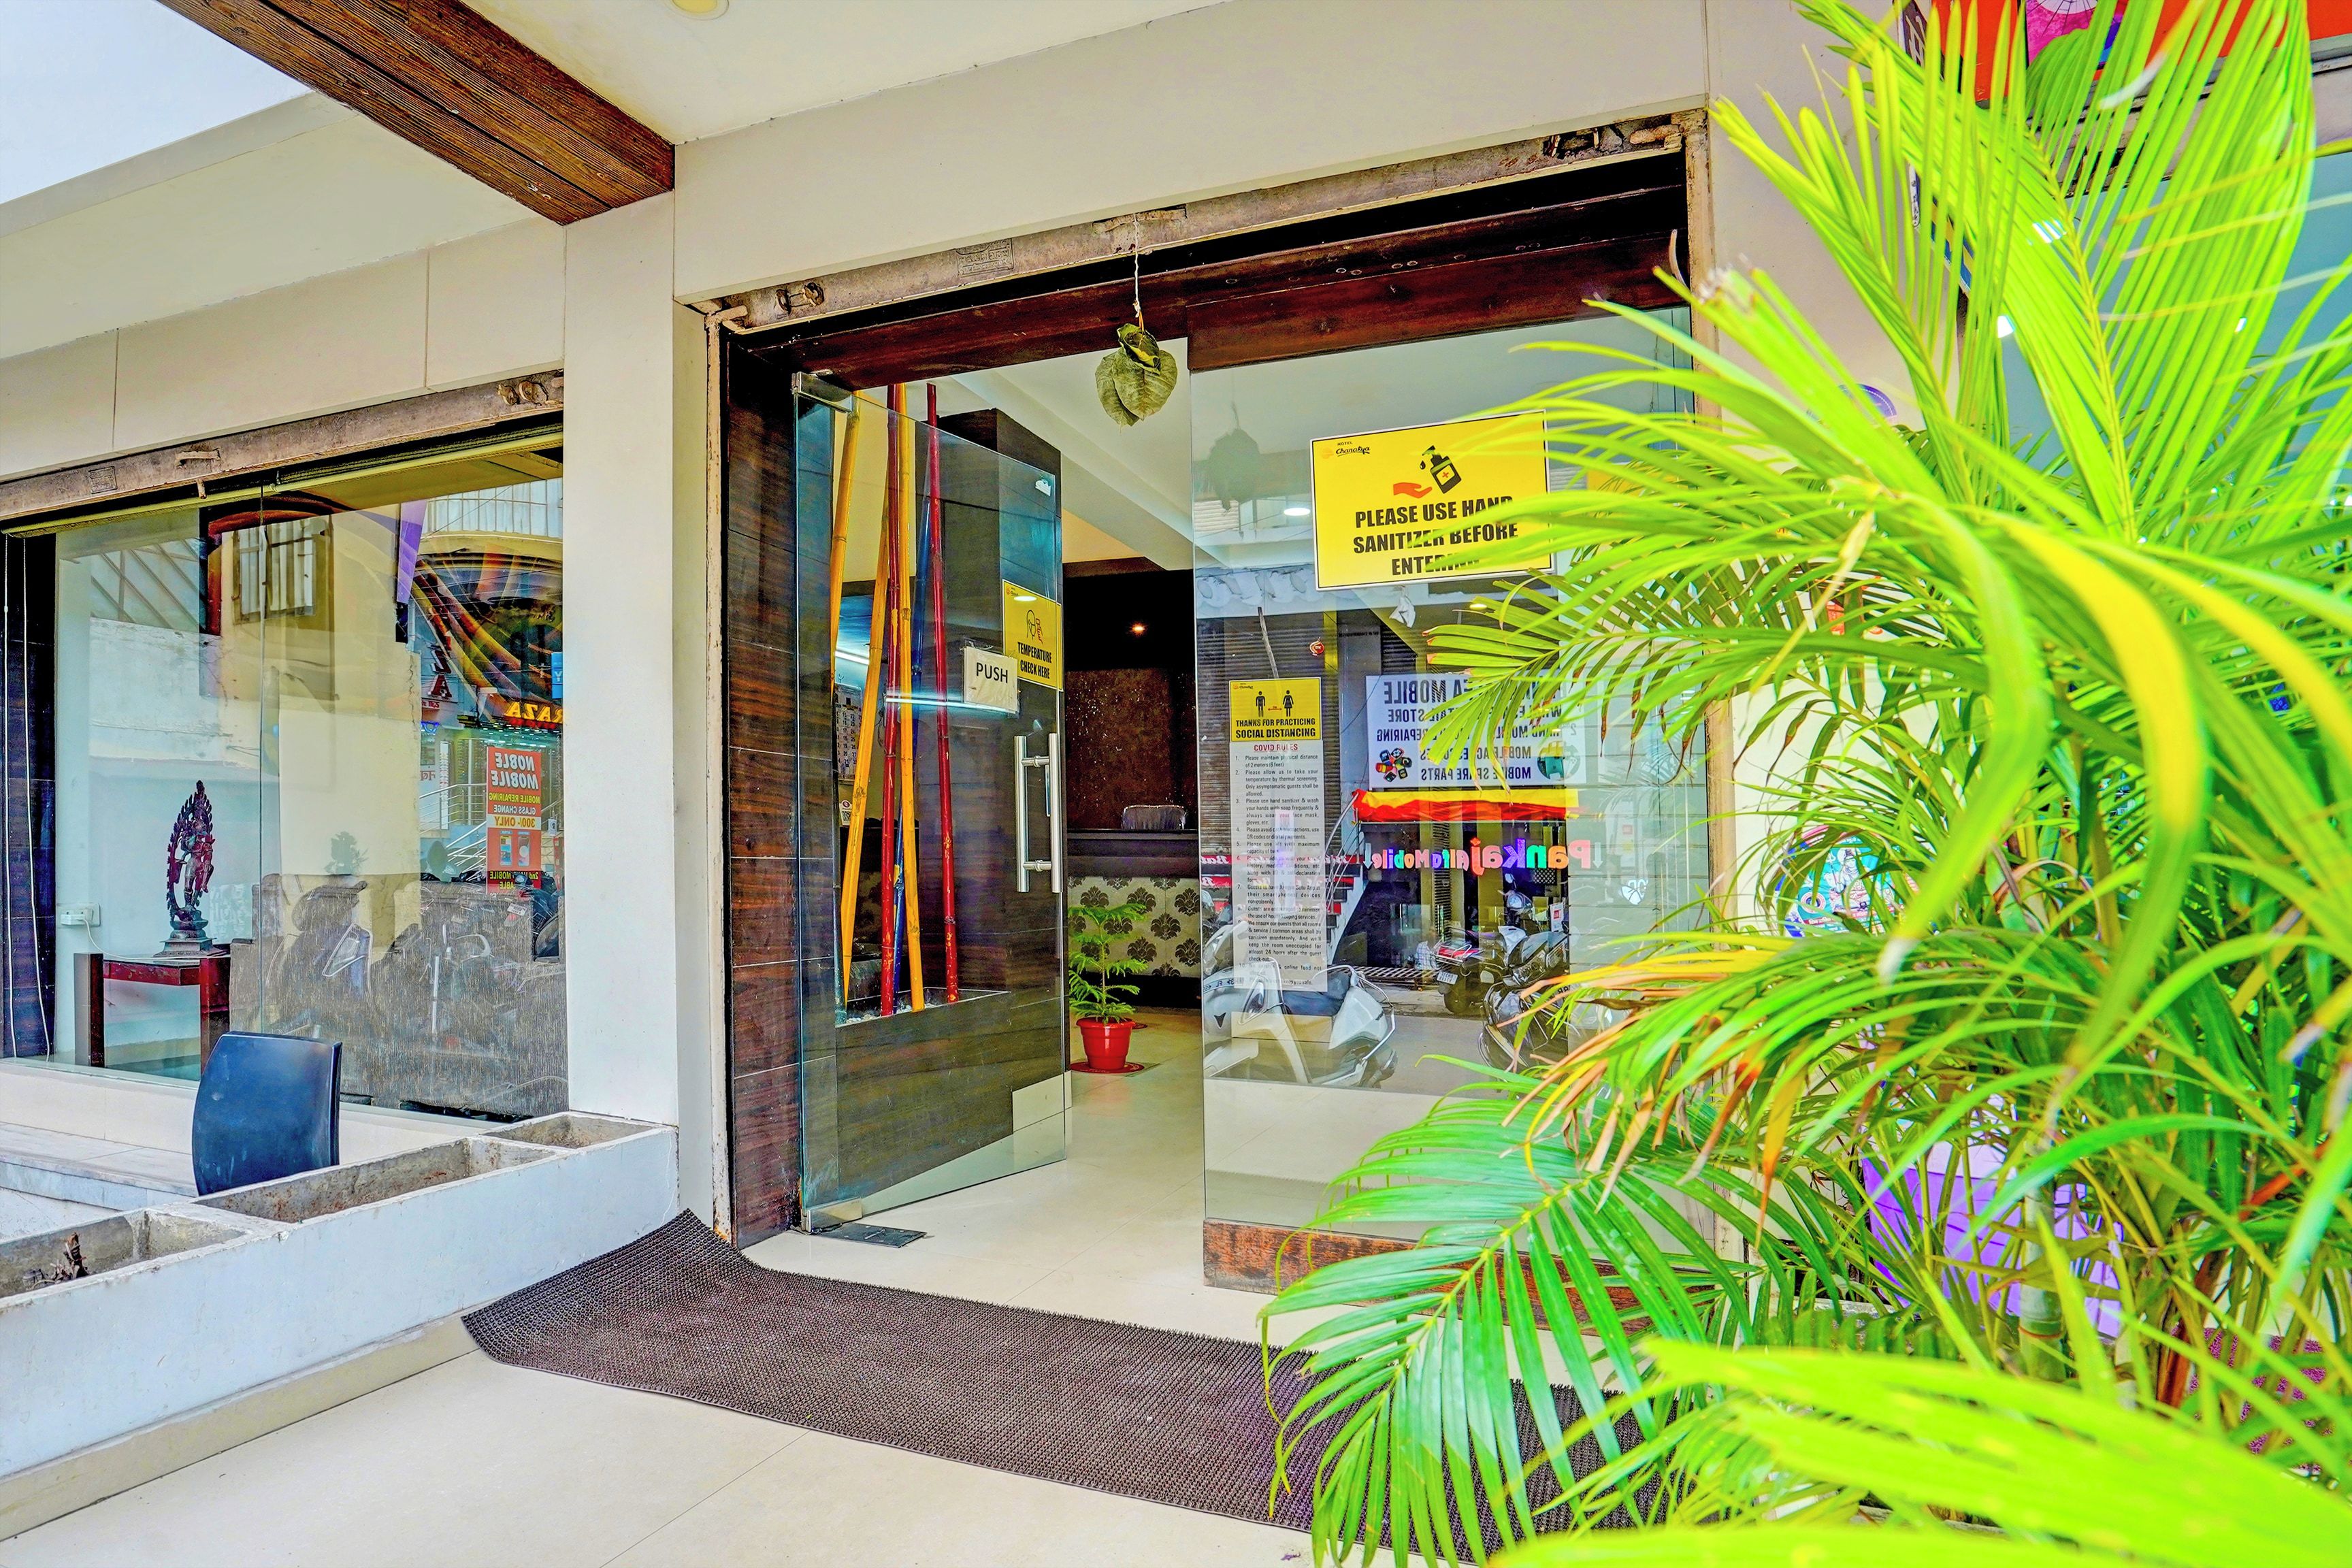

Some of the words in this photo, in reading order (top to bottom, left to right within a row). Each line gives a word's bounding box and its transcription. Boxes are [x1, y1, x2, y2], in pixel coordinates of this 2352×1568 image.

[1356, 506, 1418, 528] PLEASE
[1422, 502, 1457, 521] USE
[1017, 642, 1052, 664] TEMPERATURE
[976, 662, 1008, 683] PUSH
[1020, 659, 1037, 676] CHECK
[1038, 664, 1050, 679] HERE
[1276, 718, 1316, 726] PRACTICING
[1236, 729, 1264, 738] SOCIAL
[1267, 728, 1316, 738] DISTANCING
